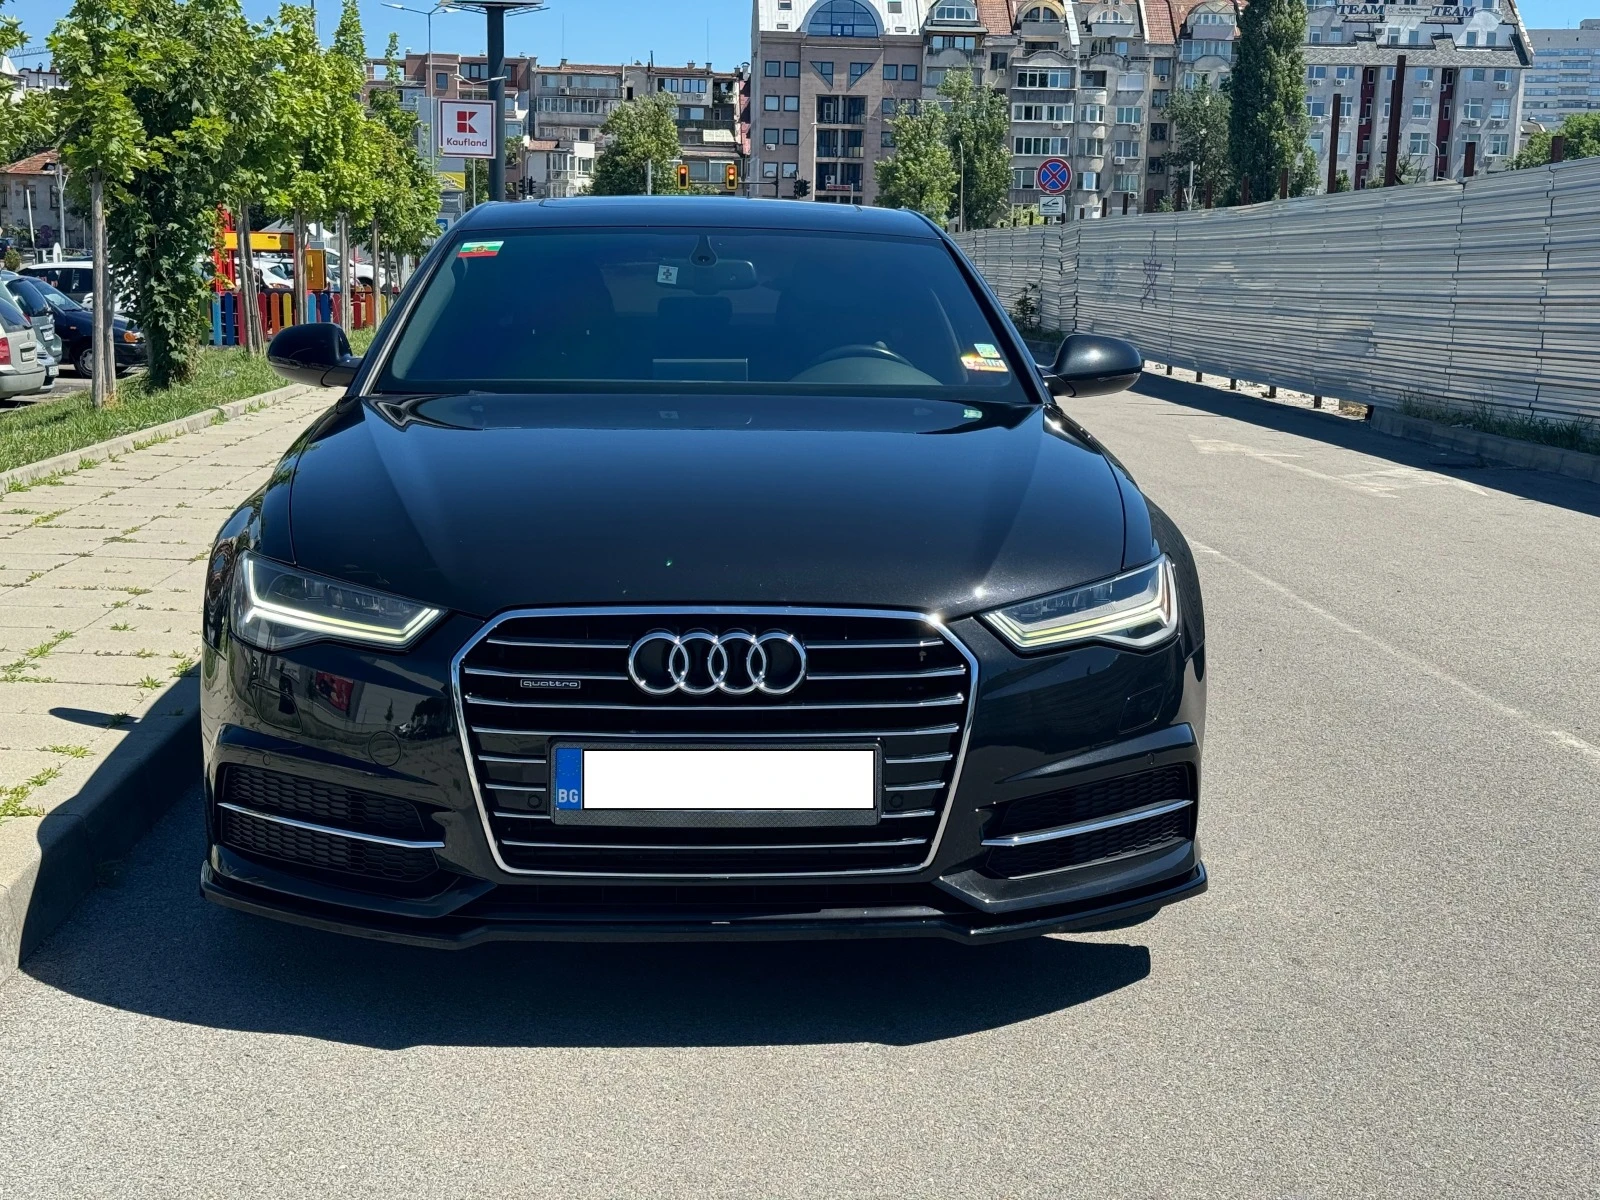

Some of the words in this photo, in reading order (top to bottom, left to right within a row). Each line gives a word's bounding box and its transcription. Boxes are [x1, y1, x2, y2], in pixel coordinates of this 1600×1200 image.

[1338, 5, 1384, 15] TEAM
[1433, 6, 1476, 17] TEAM
[446, 138, 488, 147] Kaufland
[558, 789, 579, 803] BG
